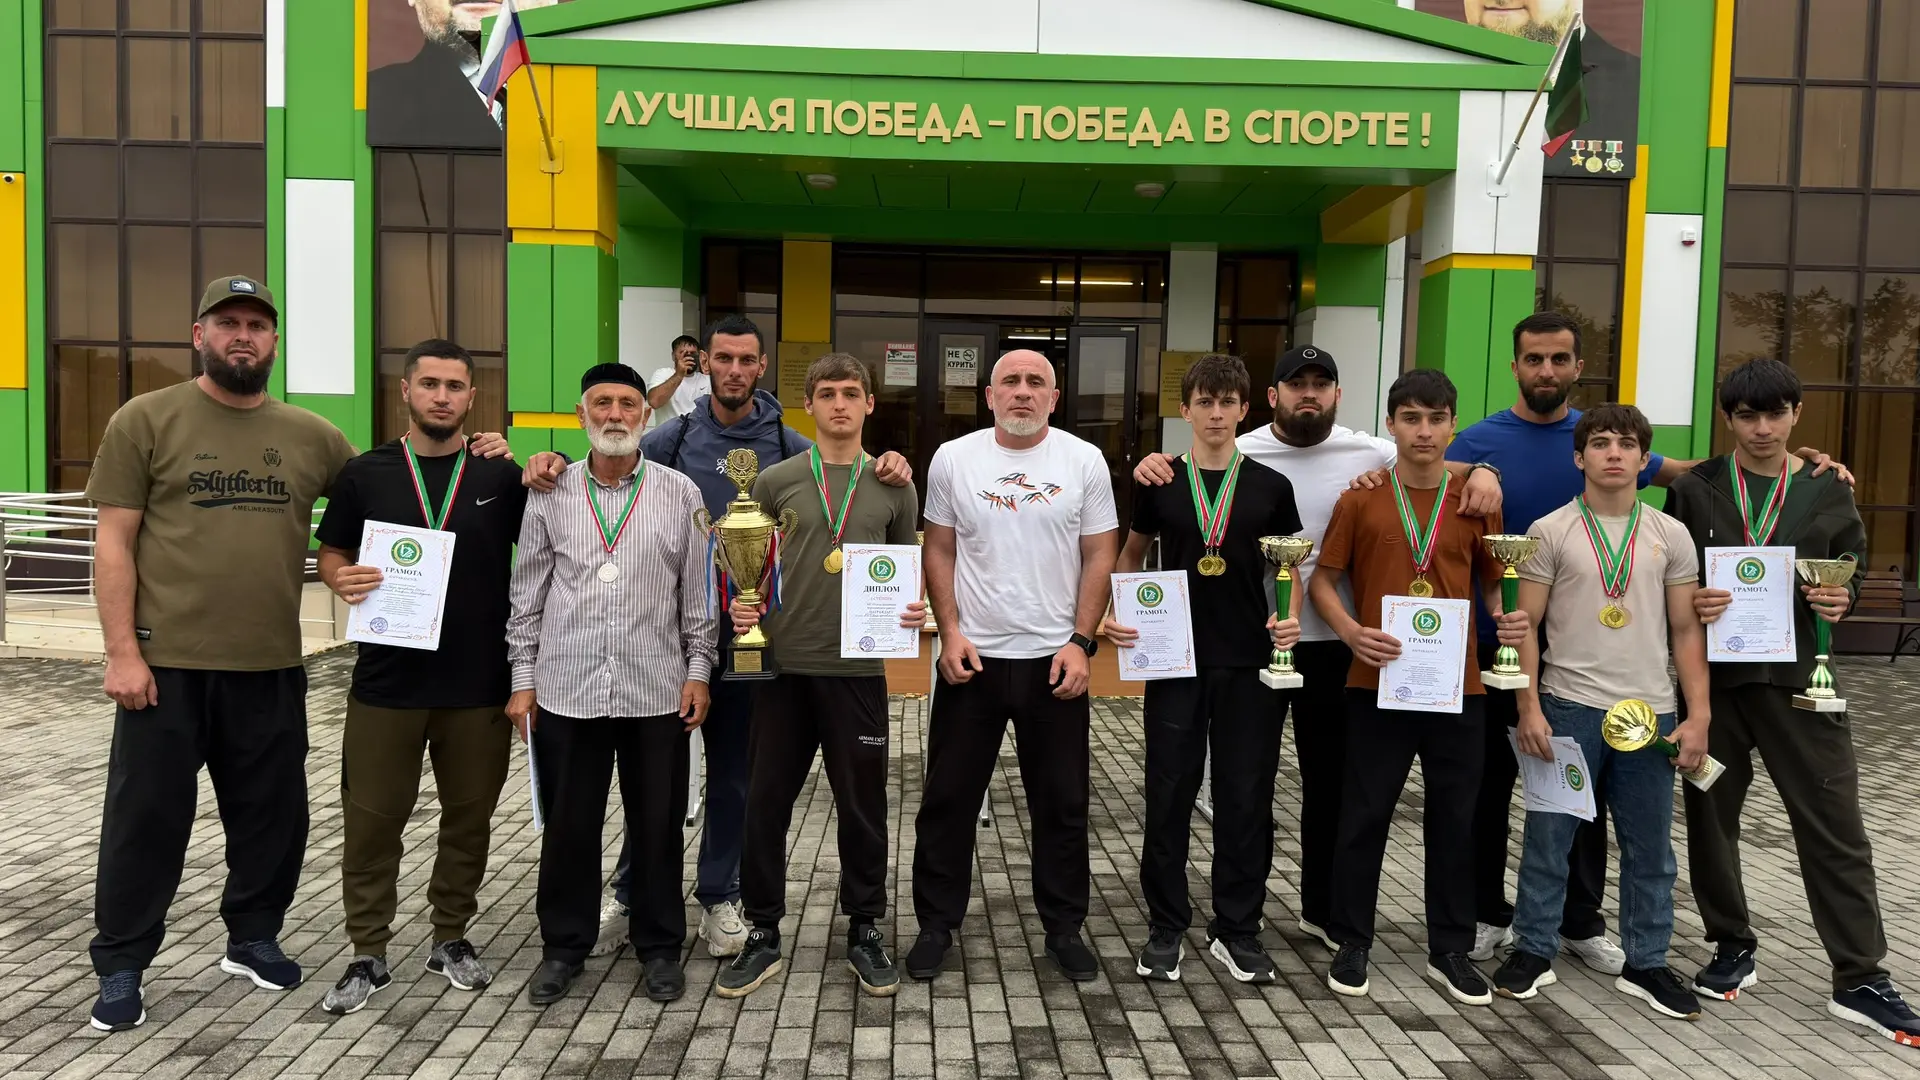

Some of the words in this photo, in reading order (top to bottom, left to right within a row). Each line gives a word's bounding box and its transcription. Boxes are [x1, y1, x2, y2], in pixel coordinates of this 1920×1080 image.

[604, 90, 795, 133] ЛУЧШАЯ
[805, 98, 983, 143] ПОБЕДА
[1015, 104, 1195, 148] ПОБЕДА
[1204, 107, 1231, 143] В
[1243, 109, 1410, 146] СПОРТЕ
[947, 350, 960, 358] НЕ
[947, 361, 976, 369] КУРИТЬ!
[187, 469, 291, 500] Slytherin
[385, 567, 423, 577] ГРАМОТА
[863, 585, 900, 593] ДИПЛОМ
[1408, 637, 1443, 645] ГРАМОТА
